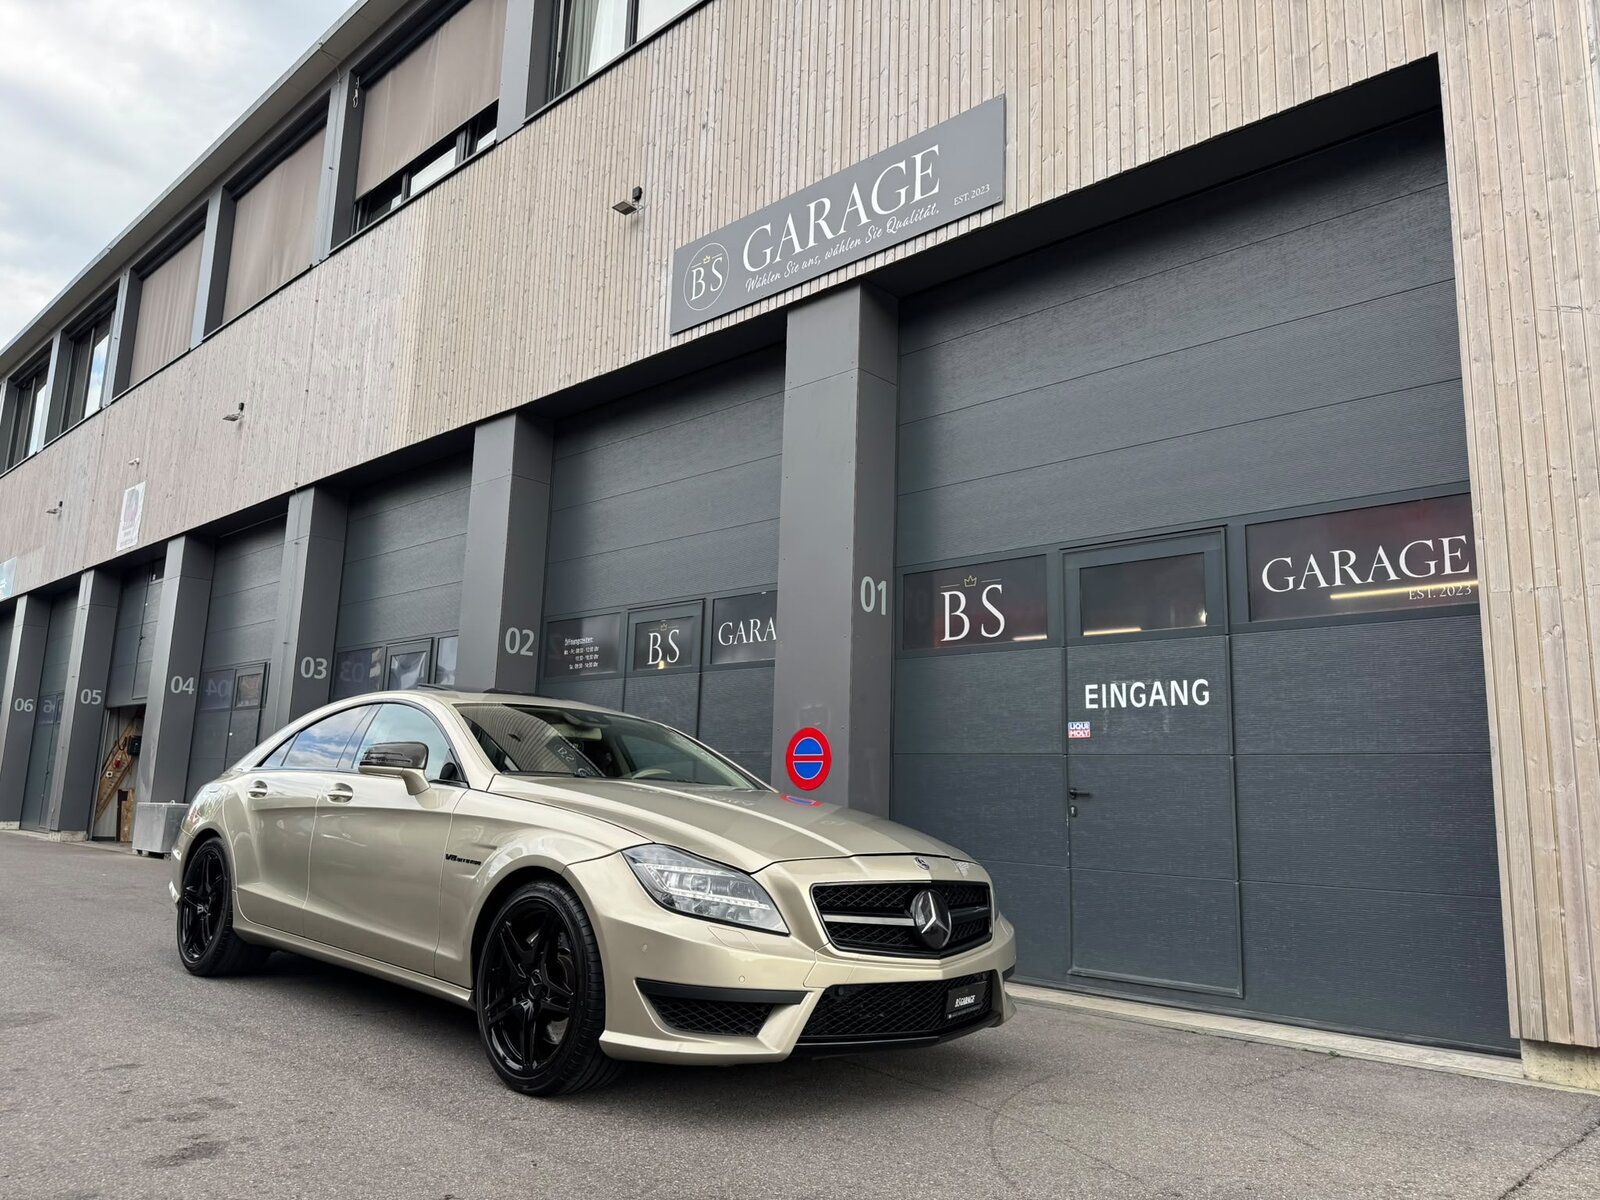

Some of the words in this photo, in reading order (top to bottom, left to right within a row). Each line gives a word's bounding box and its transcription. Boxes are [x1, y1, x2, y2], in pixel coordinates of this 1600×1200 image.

[953, 193, 970, 206] EST.
[971, 184, 990, 199] 2023
[743, 144, 940, 272] GARAGE
[745, 271, 781, 292] Wählen
[784, 260, 800, 278] Sie
[801, 256, 821, 270] uns,
[824, 237, 861, 260] wählen
[865, 225, 882, 243] Sie
[886, 202, 940, 234] Qualität.
[1261, 535, 1470, 593] GARAGE
[860, 576, 887, 615] 01
[1409, 587, 1436, 600] EST.
[1440, 584, 1472, 598] 2023
[504, 627, 534, 656] 02
[300, 656, 327, 679] 03
[80, 689, 102, 705] 05
[170, 676, 195, 695] 04
[1085, 678, 1210, 709] EINGANG
[14, 698, 34, 712] 06
[1069, 730, 1089, 738] MOLY
